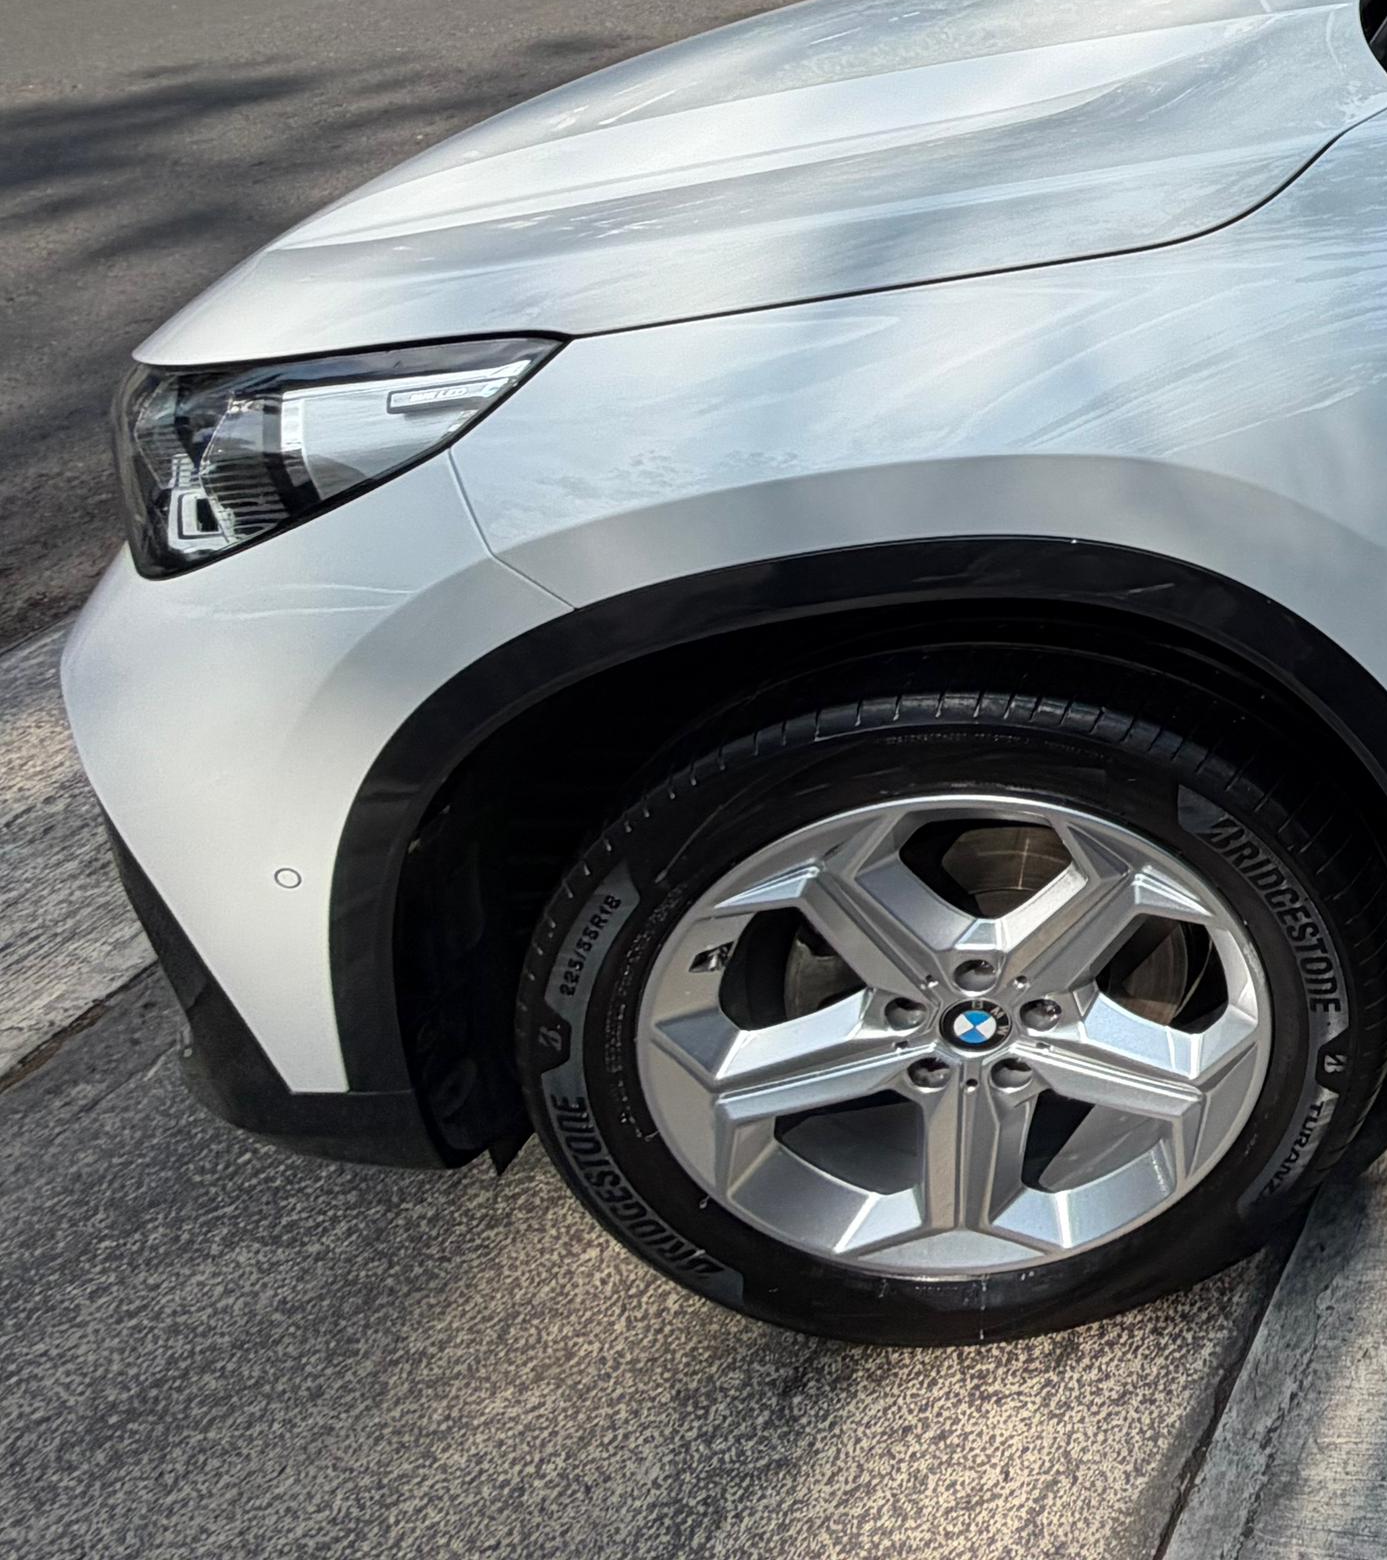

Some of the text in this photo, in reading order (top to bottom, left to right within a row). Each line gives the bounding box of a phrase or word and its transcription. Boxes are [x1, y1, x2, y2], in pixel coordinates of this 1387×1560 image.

[560, 894, 622, 997] 225/55R18
[1198, 817, 1342, 1014] BRIDGESTONE
[551, 1094, 725, 1274] BRIDGESTONE
[1255, 1102, 1323, 1202] TURANZ
